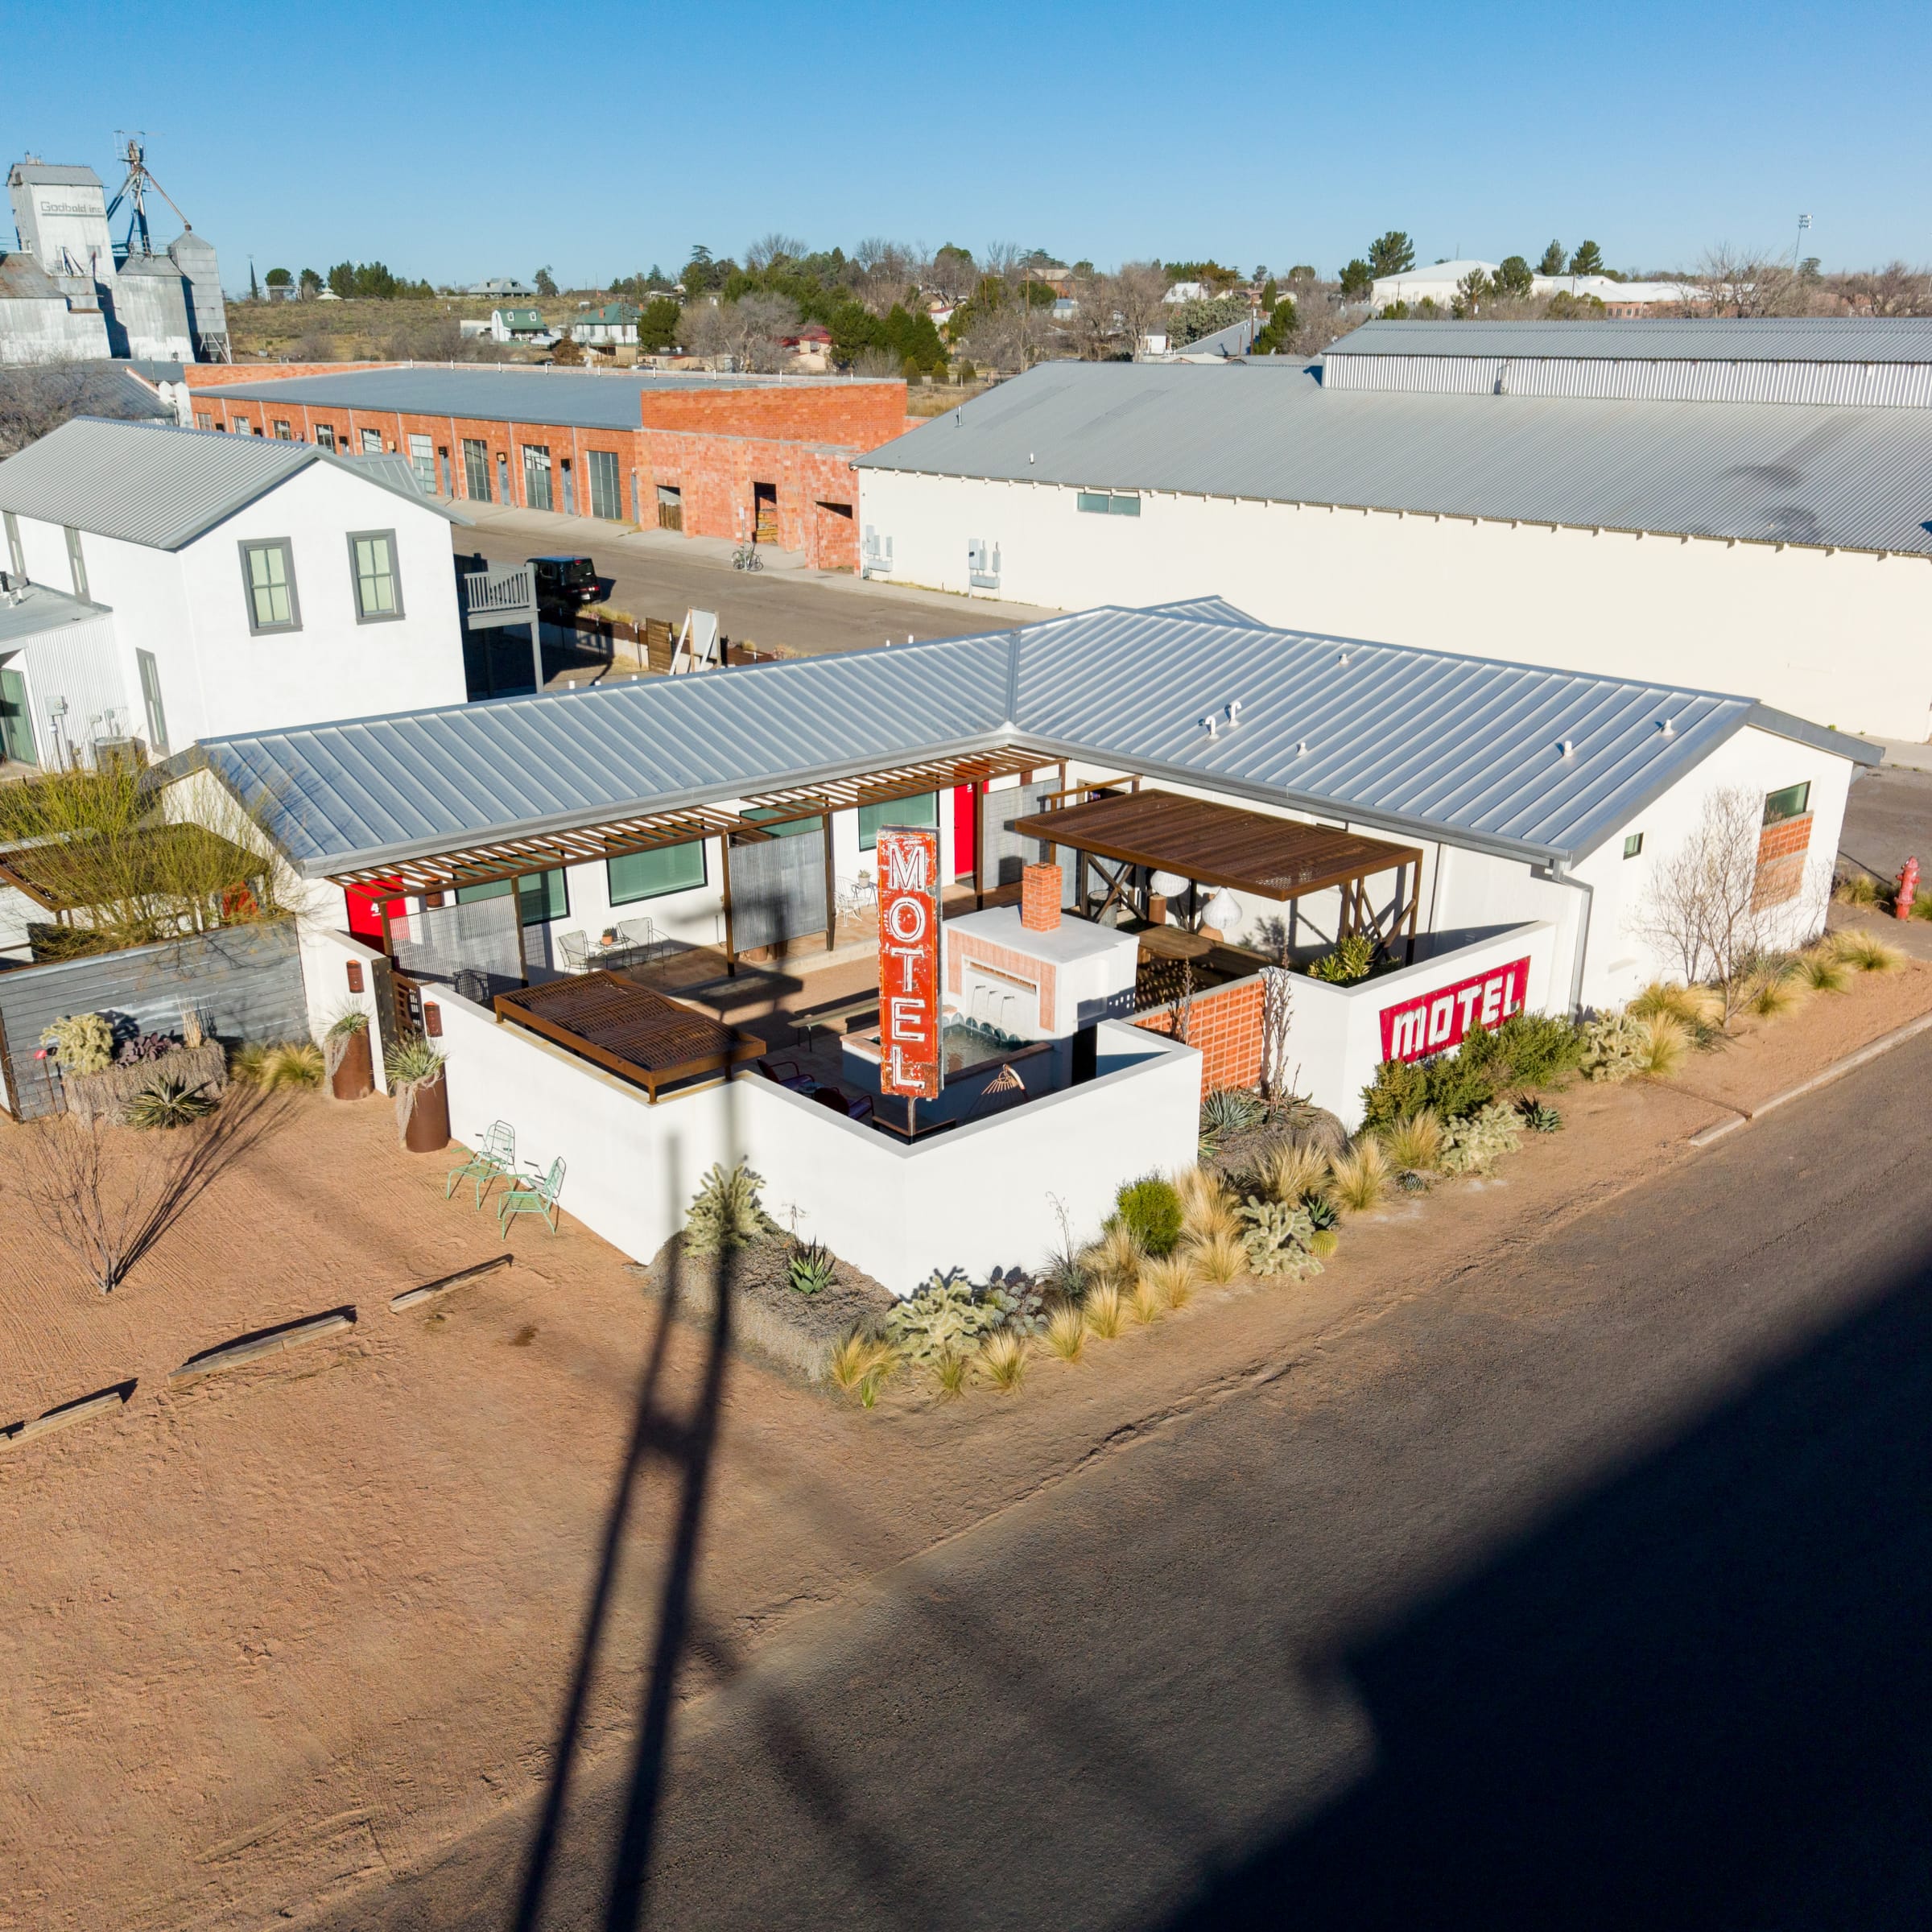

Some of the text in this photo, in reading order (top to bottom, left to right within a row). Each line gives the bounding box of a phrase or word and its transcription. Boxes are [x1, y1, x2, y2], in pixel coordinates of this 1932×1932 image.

[40, 201, 87, 213] Godbold
[890, 844, 926, 1089] MOTEL
[1391, 972, 1521, 1060] MOTEL
